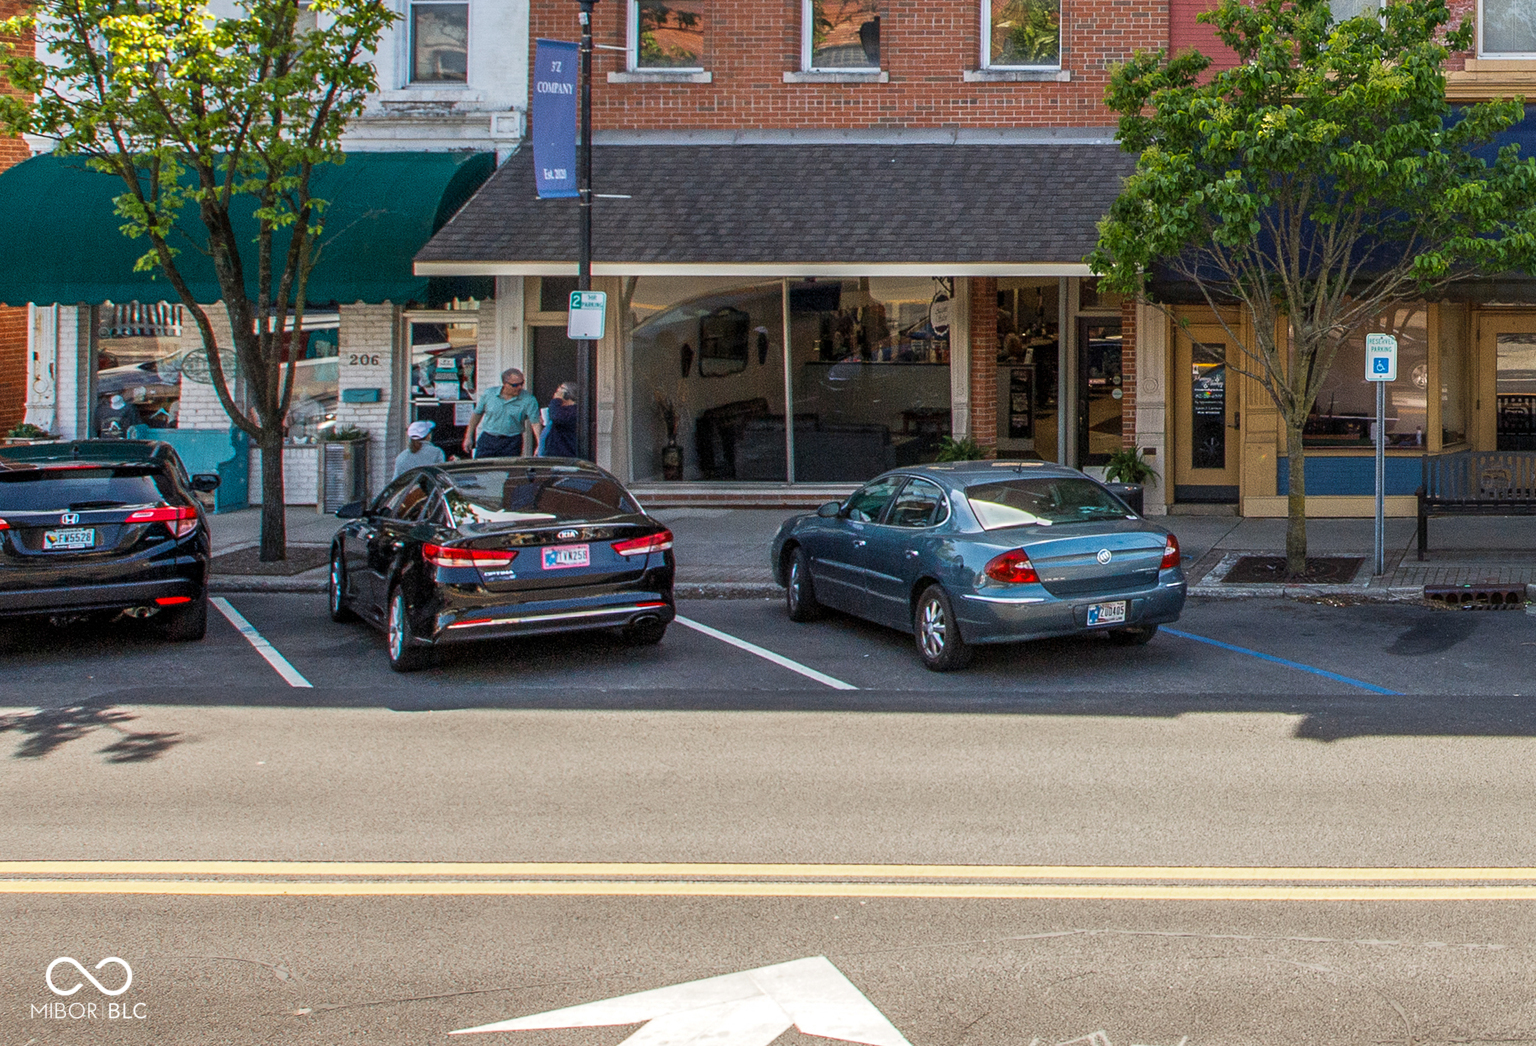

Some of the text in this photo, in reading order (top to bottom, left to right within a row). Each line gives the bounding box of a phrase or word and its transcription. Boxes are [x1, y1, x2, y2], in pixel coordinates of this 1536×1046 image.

[537, 81, 574, 95] COMPANY
[572, 294, 580, 307] 2
[349, 354, 379, 365] 206
